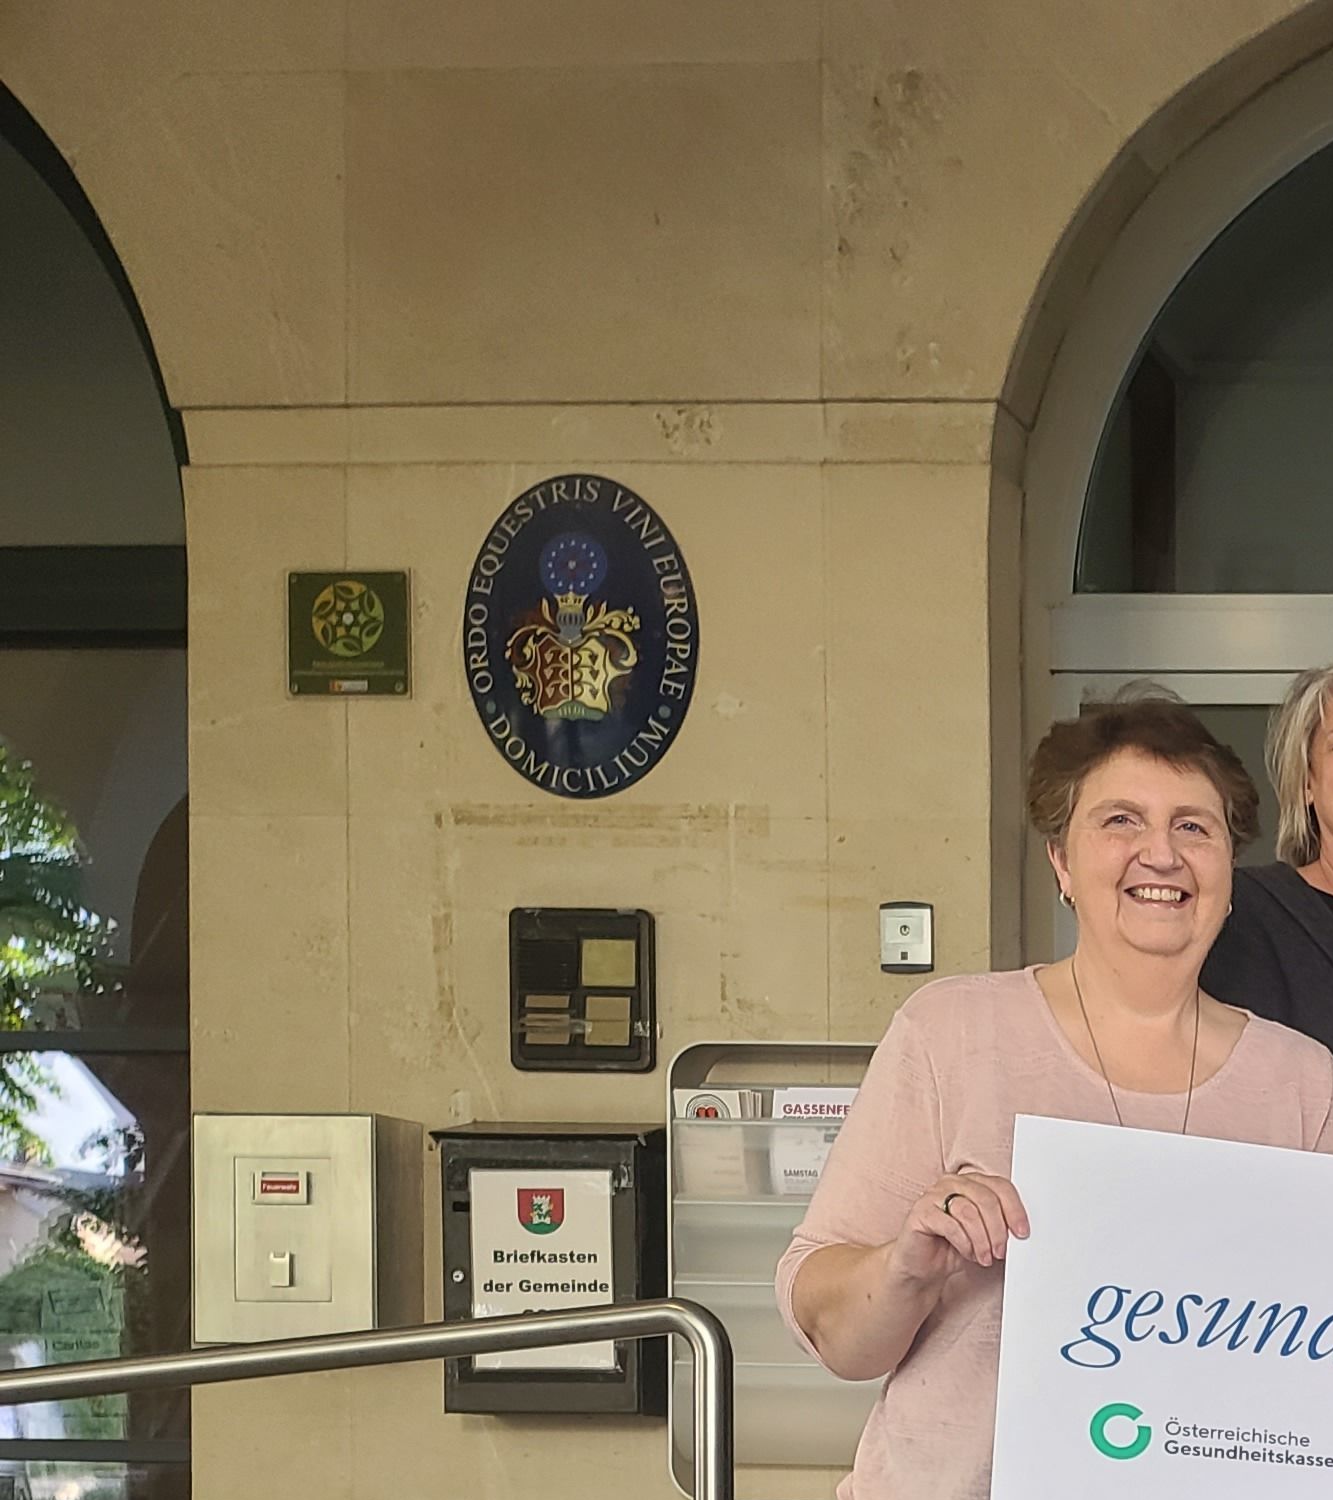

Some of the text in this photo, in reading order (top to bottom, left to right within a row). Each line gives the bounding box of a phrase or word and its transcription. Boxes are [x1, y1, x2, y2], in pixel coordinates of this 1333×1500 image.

[467, 478, 693, 701] ORDO EQUESTRIS VINI EUROPAE
[488, 713, 672, 793] DOMICILIUM
[493, 1250, 599, 1264] Briefkasten
[483, 1279, 609, 1293] der Gemeinde
[1164, 1416, 1311, 1447] Österreichische
